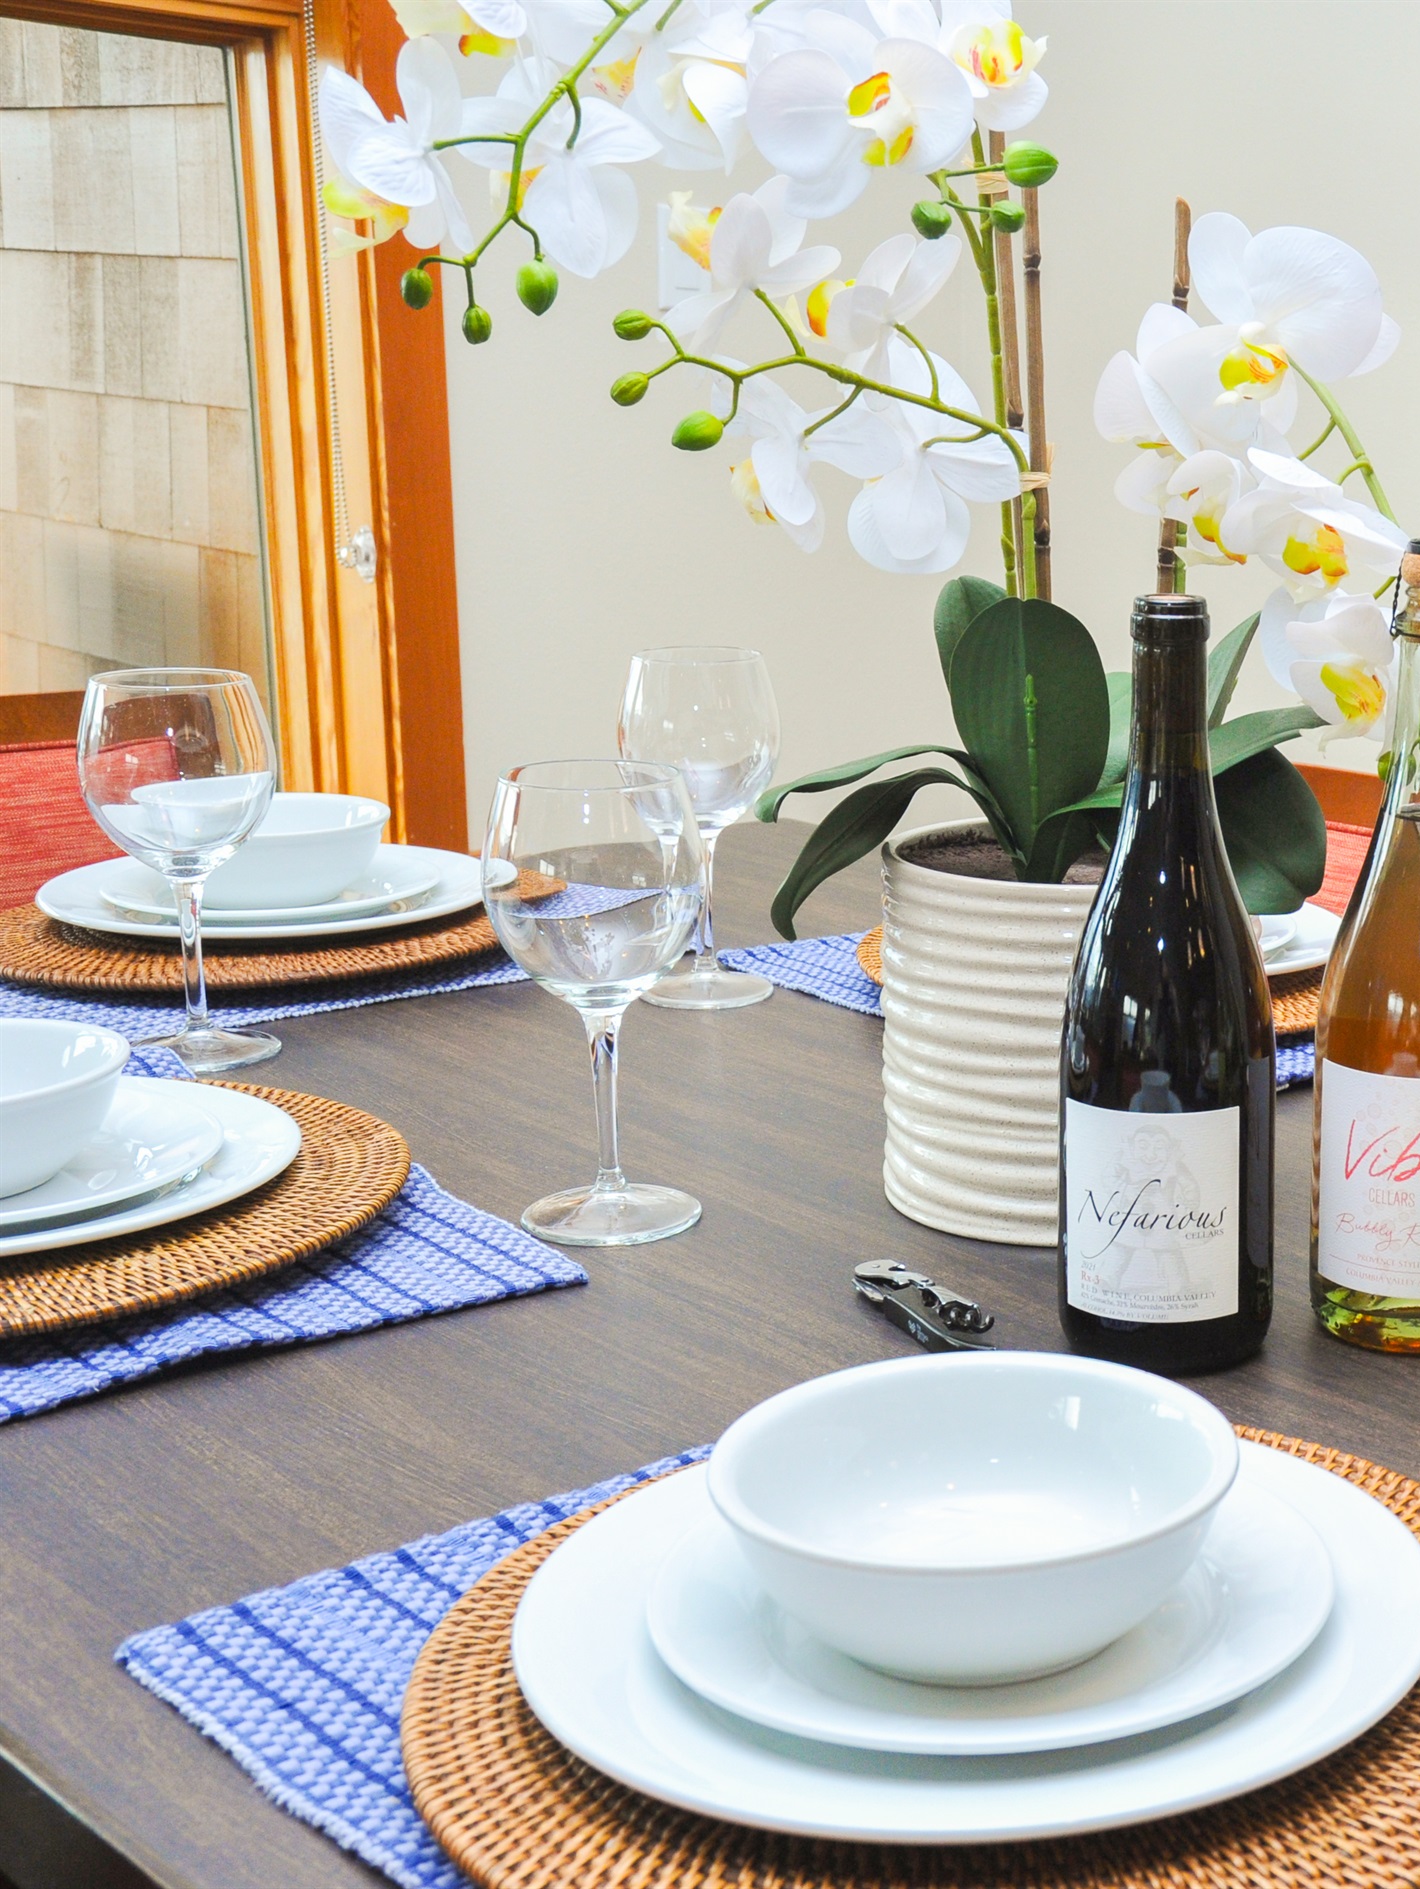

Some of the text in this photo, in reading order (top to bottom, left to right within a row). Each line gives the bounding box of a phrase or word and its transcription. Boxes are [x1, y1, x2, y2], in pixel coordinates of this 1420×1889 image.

[1368, 1187, 1415, 1208] CELLARS
[1077, 1178, 1228, 1260] Nefarious
[1185, 1228, 1225, 1240] CELLARS
[1335, 1212, 1401, 1251] Bubbly
[1080, 1260, 1096, 1271] 2021
[1357, 1253, 1420, 1269] PROVENCE STYLE
[1345, 1267, 1384, 1283] COLUMBIA
[1386, 1276, 1415, 1287] VALLEY
[1080, 1283, 1098, 1294] RED
[1133, 1292, 1182, 1303] COLUMBIA
[1183, 1290, 1217, 1302] VALLEY
